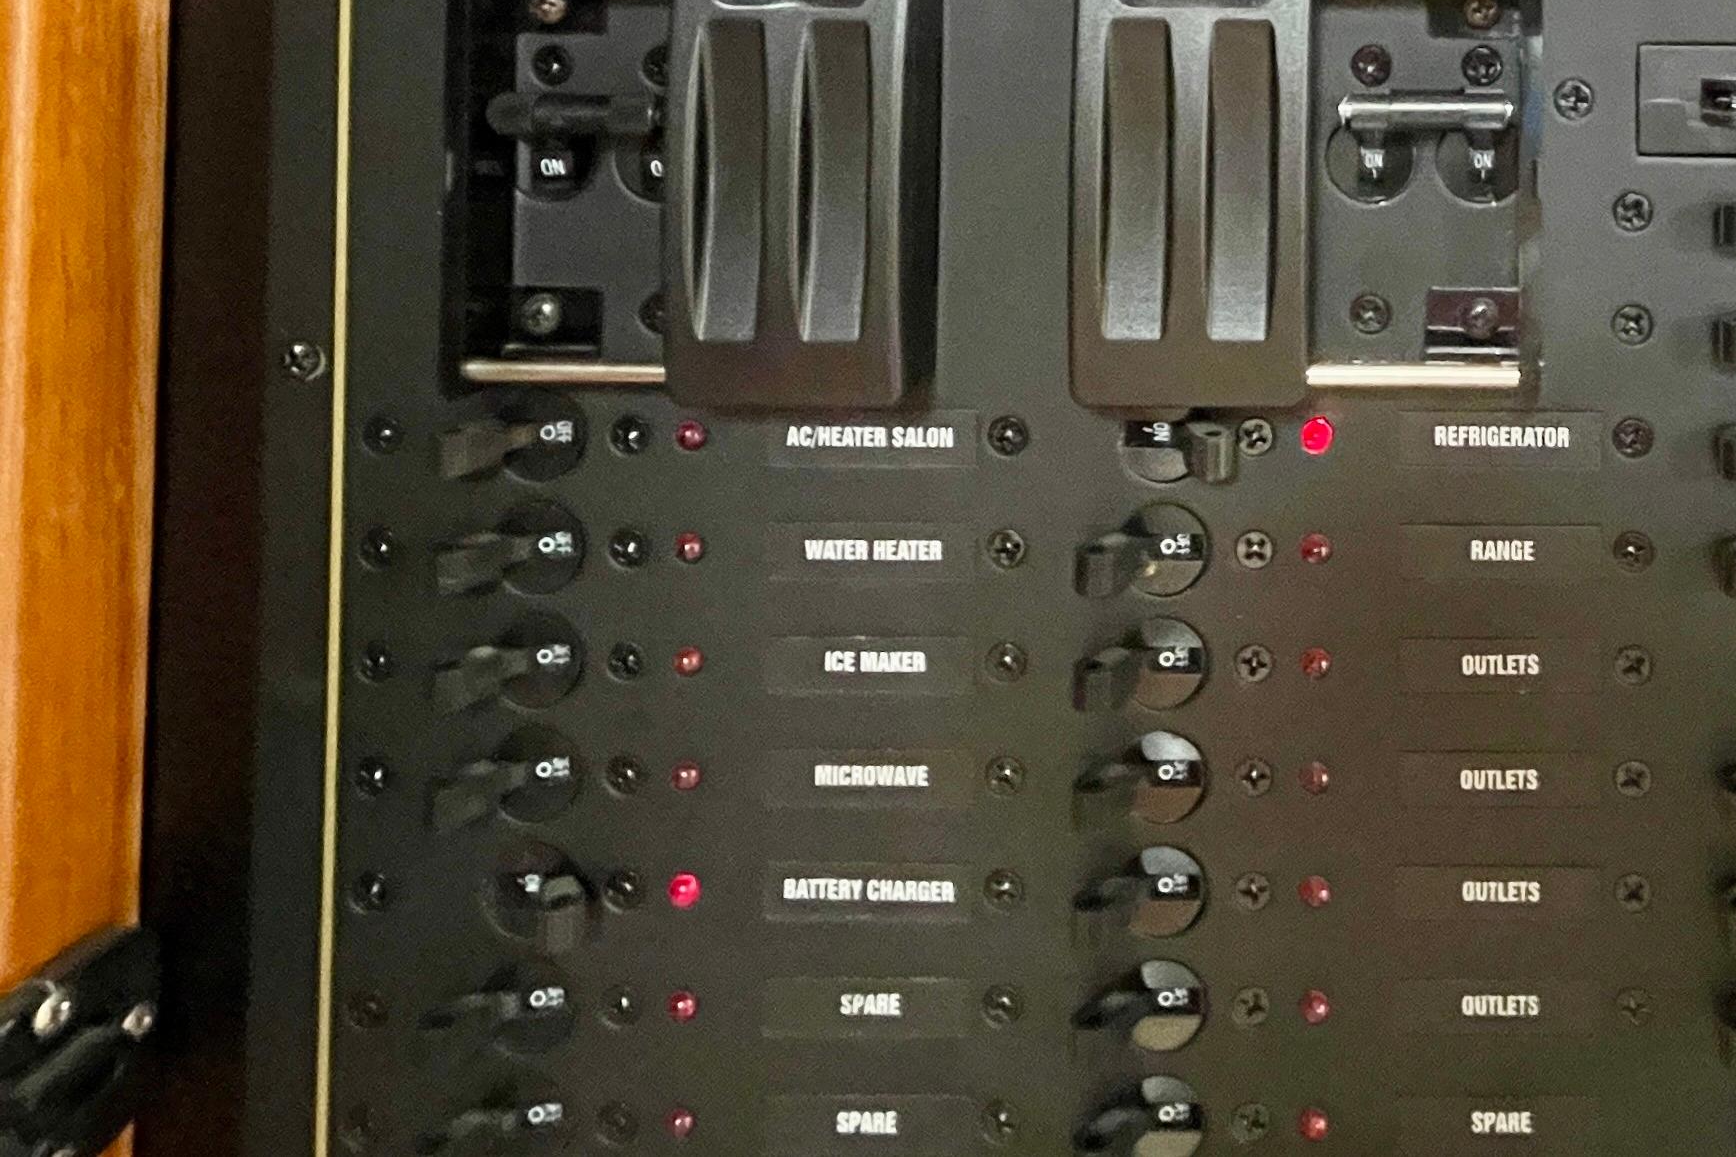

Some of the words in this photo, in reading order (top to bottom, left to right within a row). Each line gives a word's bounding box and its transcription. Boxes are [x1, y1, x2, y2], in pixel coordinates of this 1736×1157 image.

[786, 425, 888, 448] AC/HEATER
[891, 426, 954, 448] SALON
[1434, 425, 1570, 448] REFRIGERATOR
[804, 539, 869, 561] WATER
[872, 539, 943, 561] HEATER
[1470, 539, 1535, 561] RANGE
[824, 650, 856, 673] ICE
[859, 651, 927, 673] MAKER
[1461, 653, 1540, 676] OUTLETS
[814, 764, 929, 787] MICROWAVE
[1460, 768, 1539, 790] OUTLETS
[783, 878, 863, 901] BATTERY
[866, 879, 955, 903] CHARGER
[1462, 881, 1541, 903] OUTLETS
[840, 992, 901, 1016] SPARE
[1461, 994, 1539, 1016] OUTLETS
[836, 1110, 898, 1135] SPARE
[1471, 1111, 1533, 1134] SPARE
